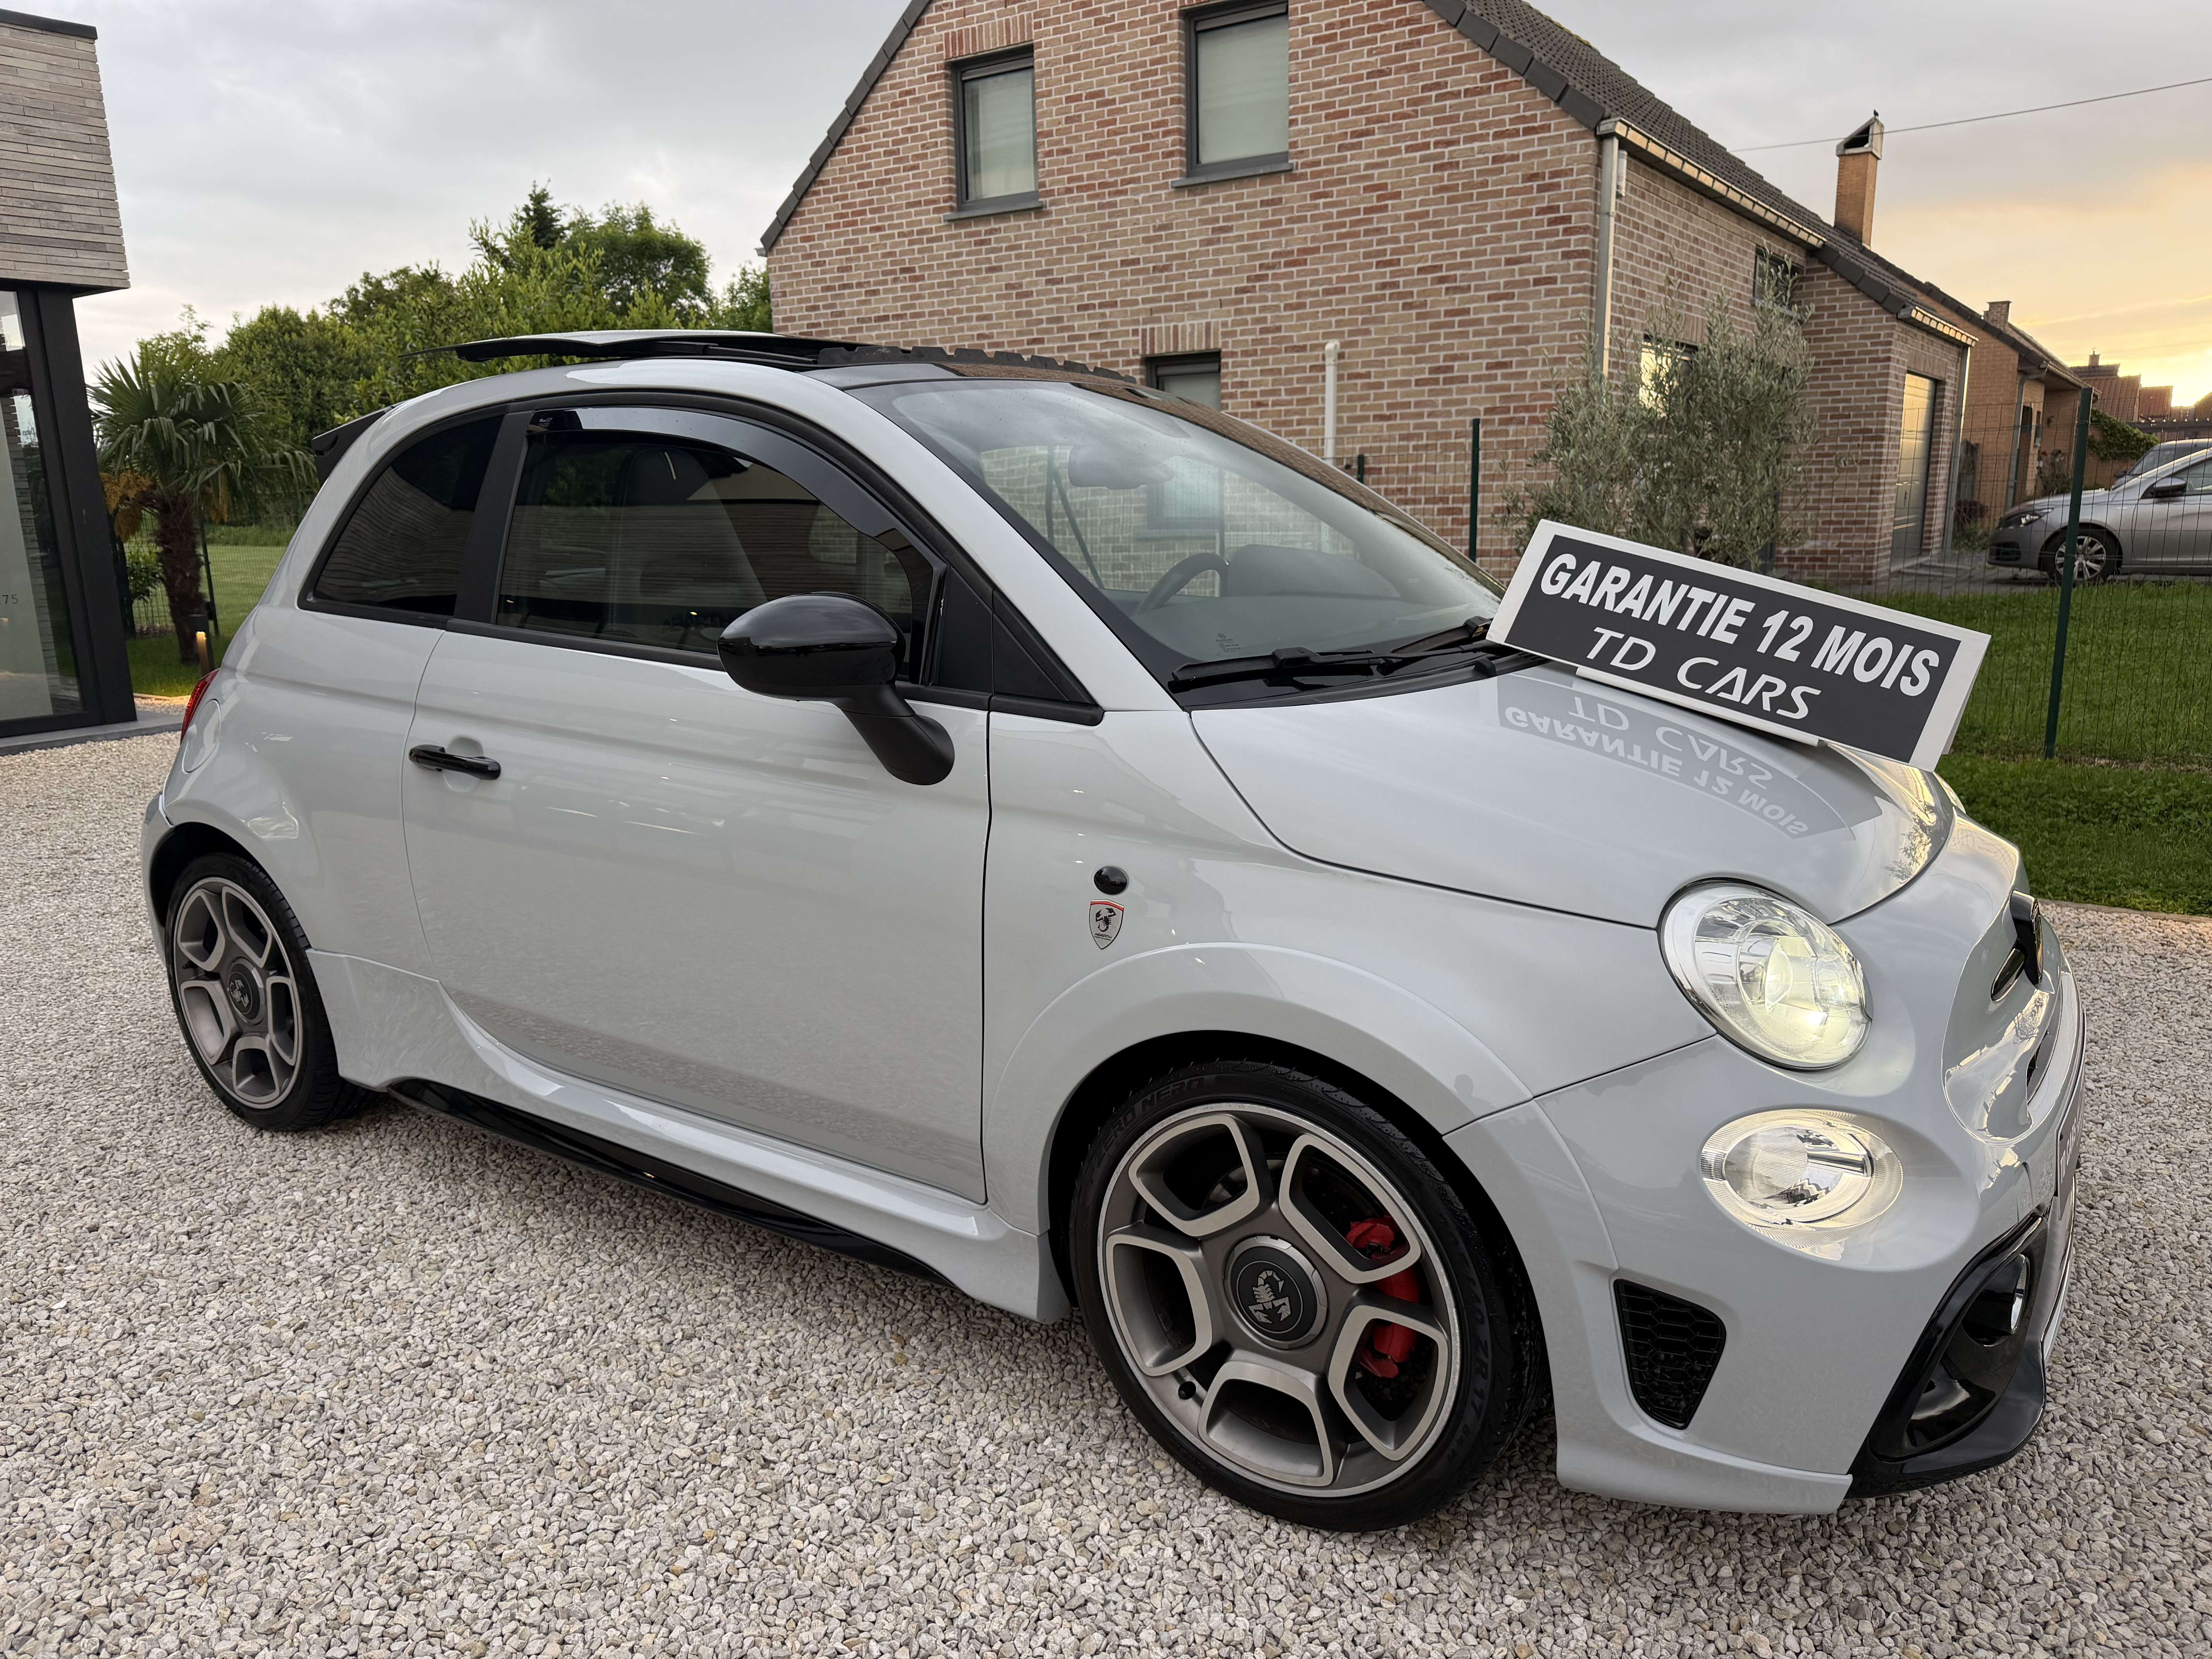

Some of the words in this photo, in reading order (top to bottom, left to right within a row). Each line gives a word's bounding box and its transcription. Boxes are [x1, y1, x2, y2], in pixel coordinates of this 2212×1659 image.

[1541, 553, 1756, 644] GARANTIE
[1757, 610, 1813, 662] 12
[1810, 625, 1939, 696] MOIS
[1587, 627, 1656, 670] TD
[1677, 657, 1821, 719] CARS
